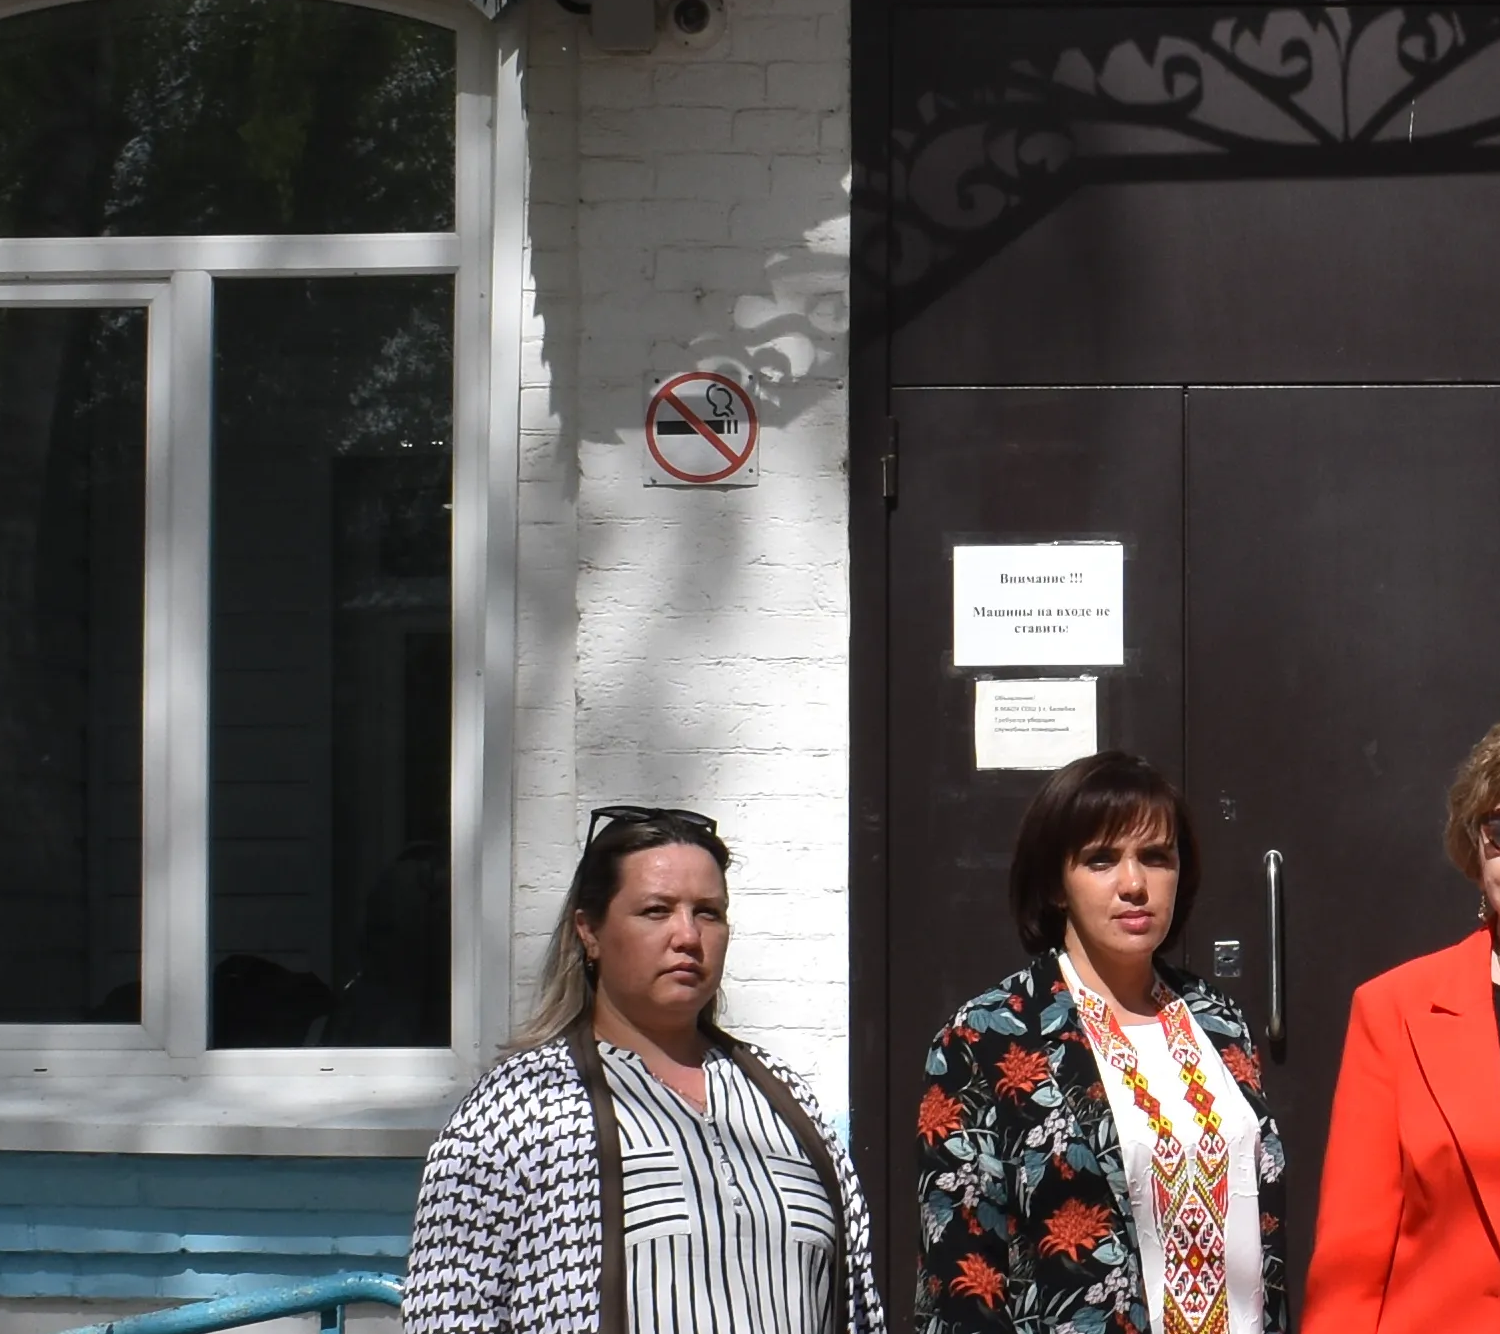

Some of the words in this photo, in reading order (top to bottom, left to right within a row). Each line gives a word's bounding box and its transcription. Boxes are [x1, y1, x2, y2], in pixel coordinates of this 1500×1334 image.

[1000, 573, 1065, 584] Внимание
[1070, 573, 1083, 584] !!!
[973, 607, 1033, 617] Машины
[1038, 608, 1052, 616] на
[1056, 608, 1092, 617] входе
[1096, 607, 1110, 616] не
